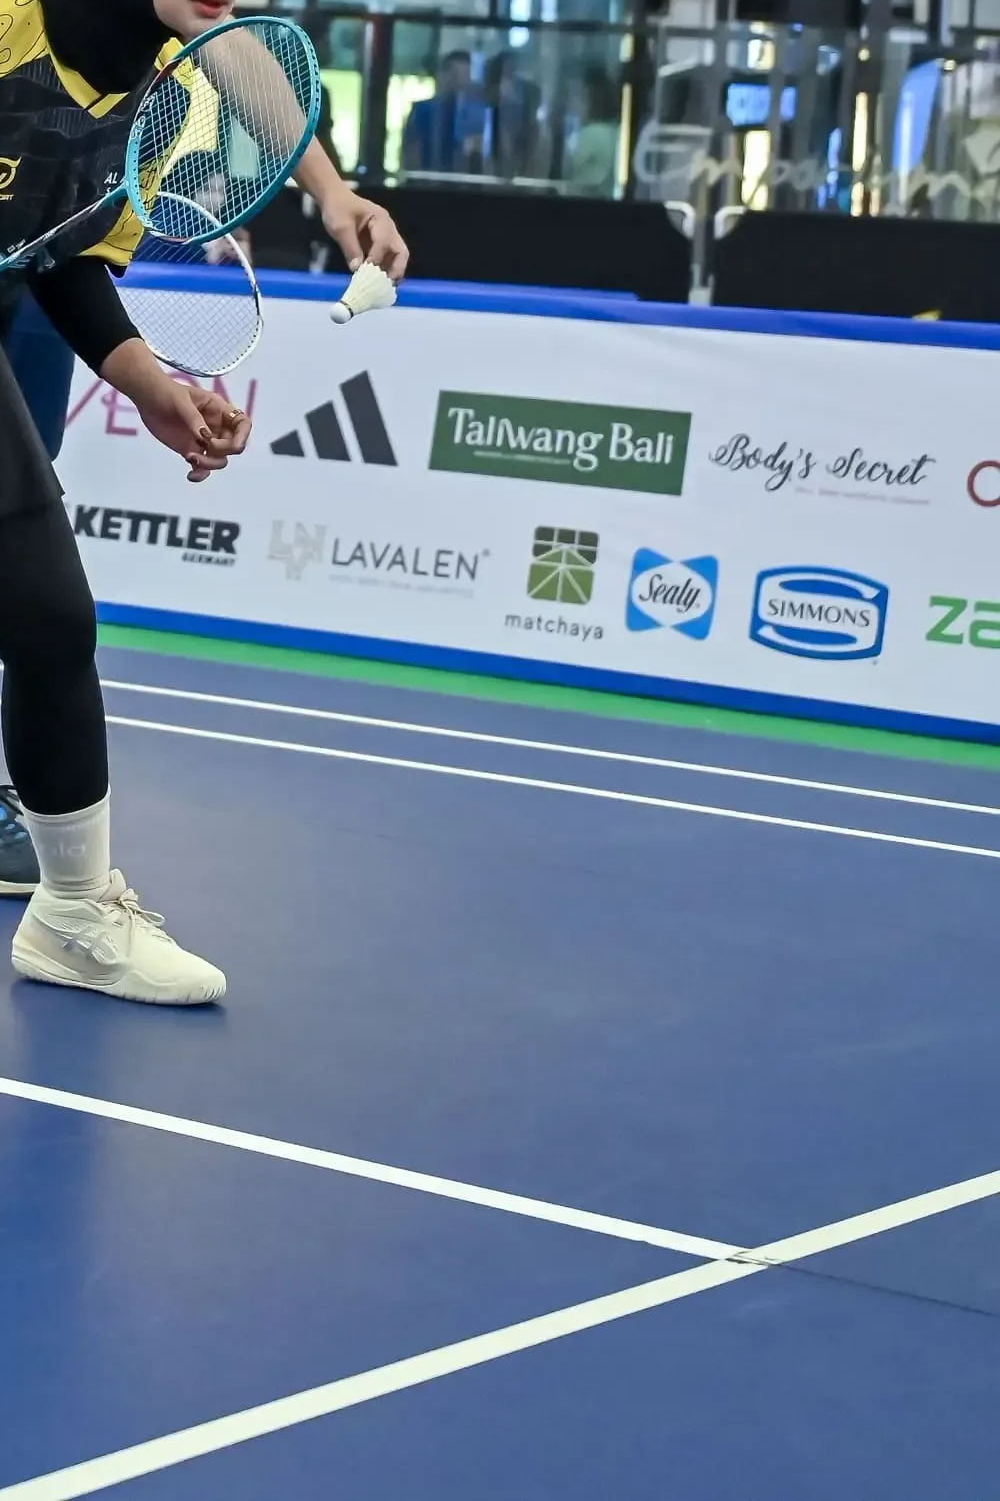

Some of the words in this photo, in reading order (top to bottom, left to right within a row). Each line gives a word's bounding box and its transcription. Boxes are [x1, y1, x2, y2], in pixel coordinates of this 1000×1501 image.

[608, 422, 674, 465] Bali
[708, 433, 816, 492] Body's
[825, 447, 937, 486] Secret
[73, 503, 241, 555] KETTLER
[331, 538, 480, 582] LAVALEN
[638, 573, 702, 614] Sealy
[767, 598, 871, 628] SIMMONS
[504, 613, 604, 642] matchaya
